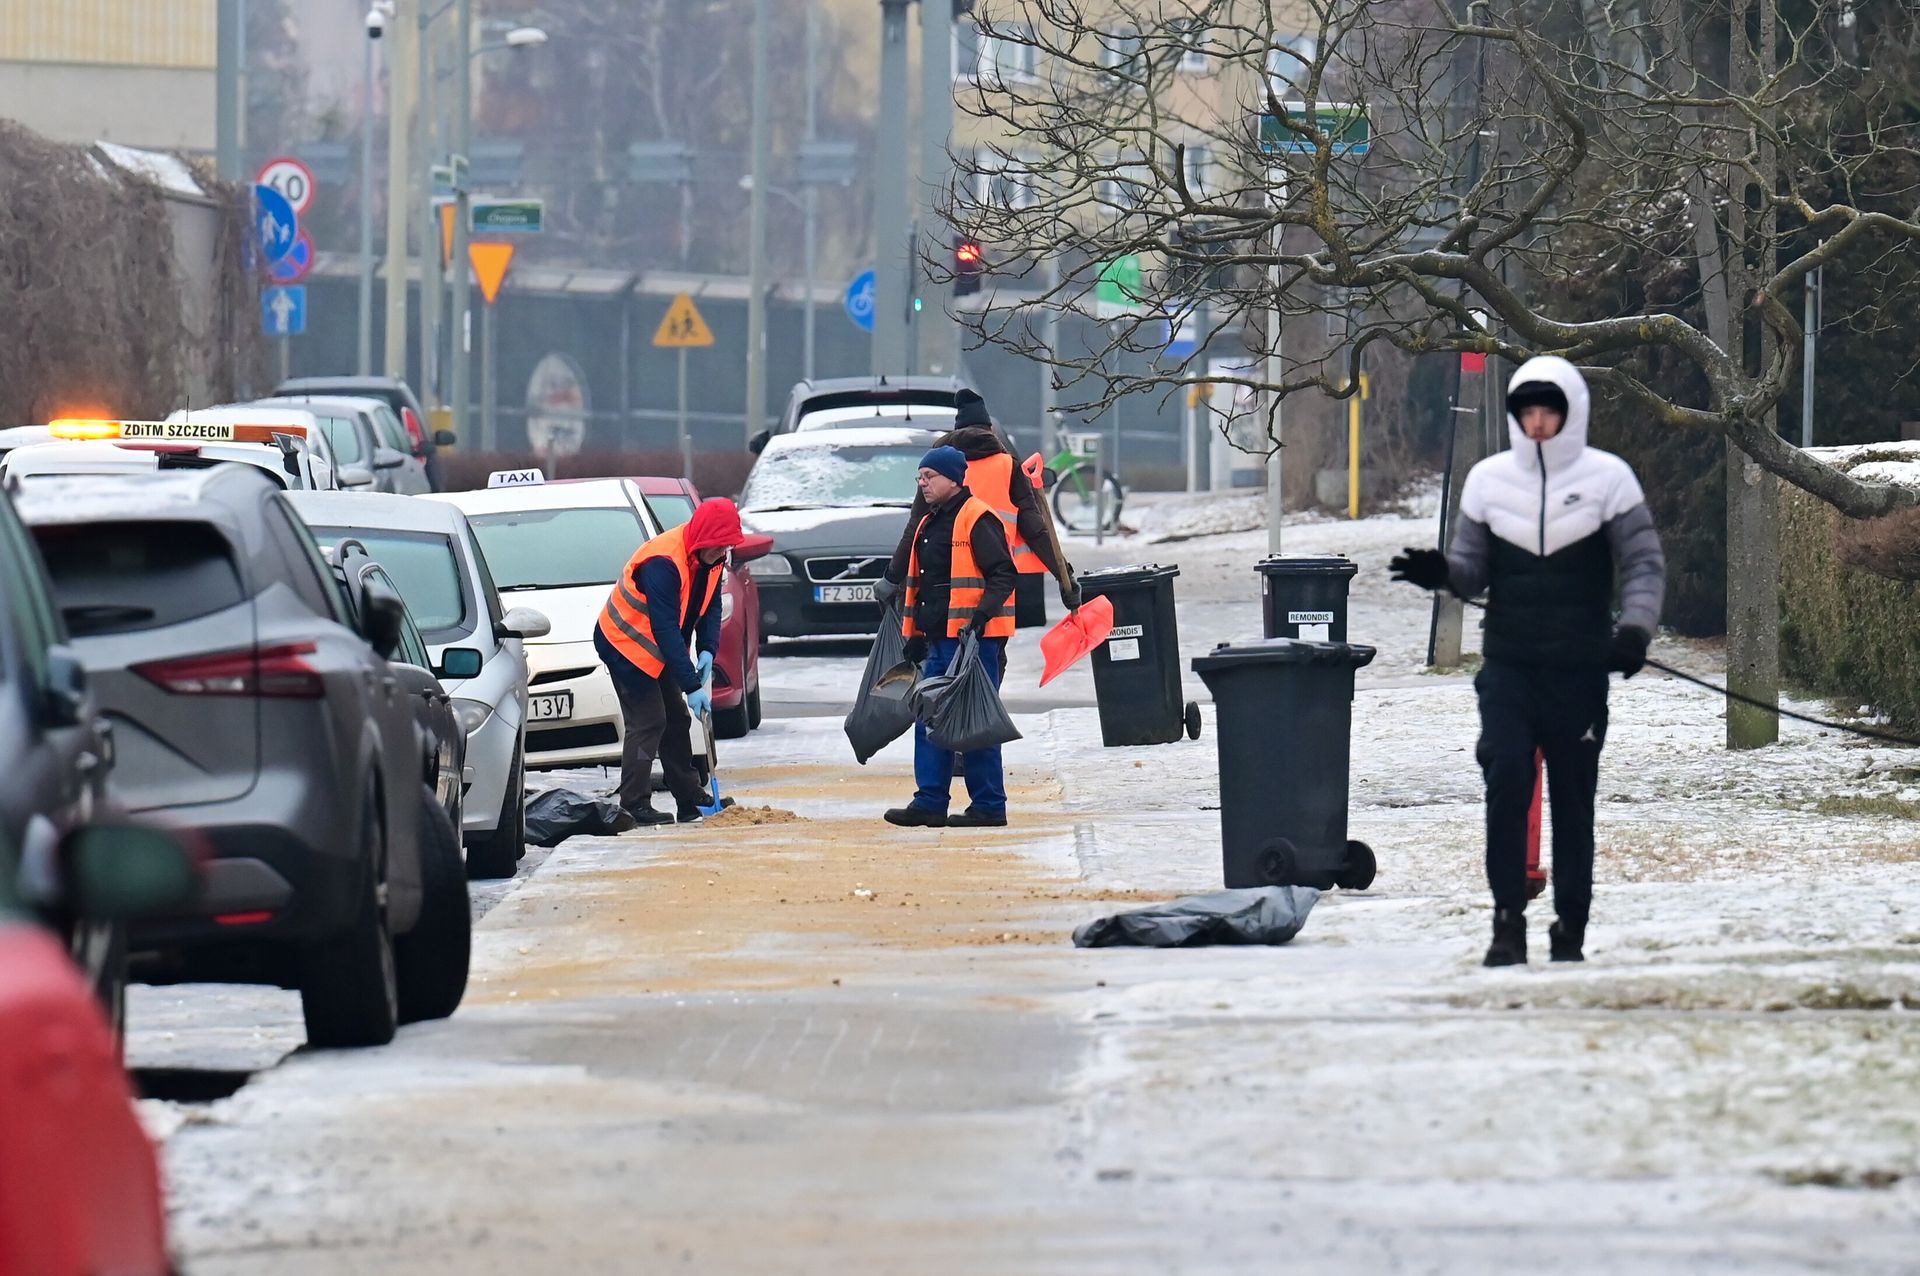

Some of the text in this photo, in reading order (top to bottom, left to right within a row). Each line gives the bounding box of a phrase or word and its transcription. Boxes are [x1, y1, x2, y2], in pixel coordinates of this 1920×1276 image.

[168, 425, 229, 437] SZCZECIN
[497, 471, 535, 483] TAXI
[823, 587, 842, 601] FZ
[847, 587, 873, 601] 302
[1290, 613, 1329, 621] REMONDIS
[1108, 627, 1139, 637] MONDIS
[532, 697, 565, 717] 13V
